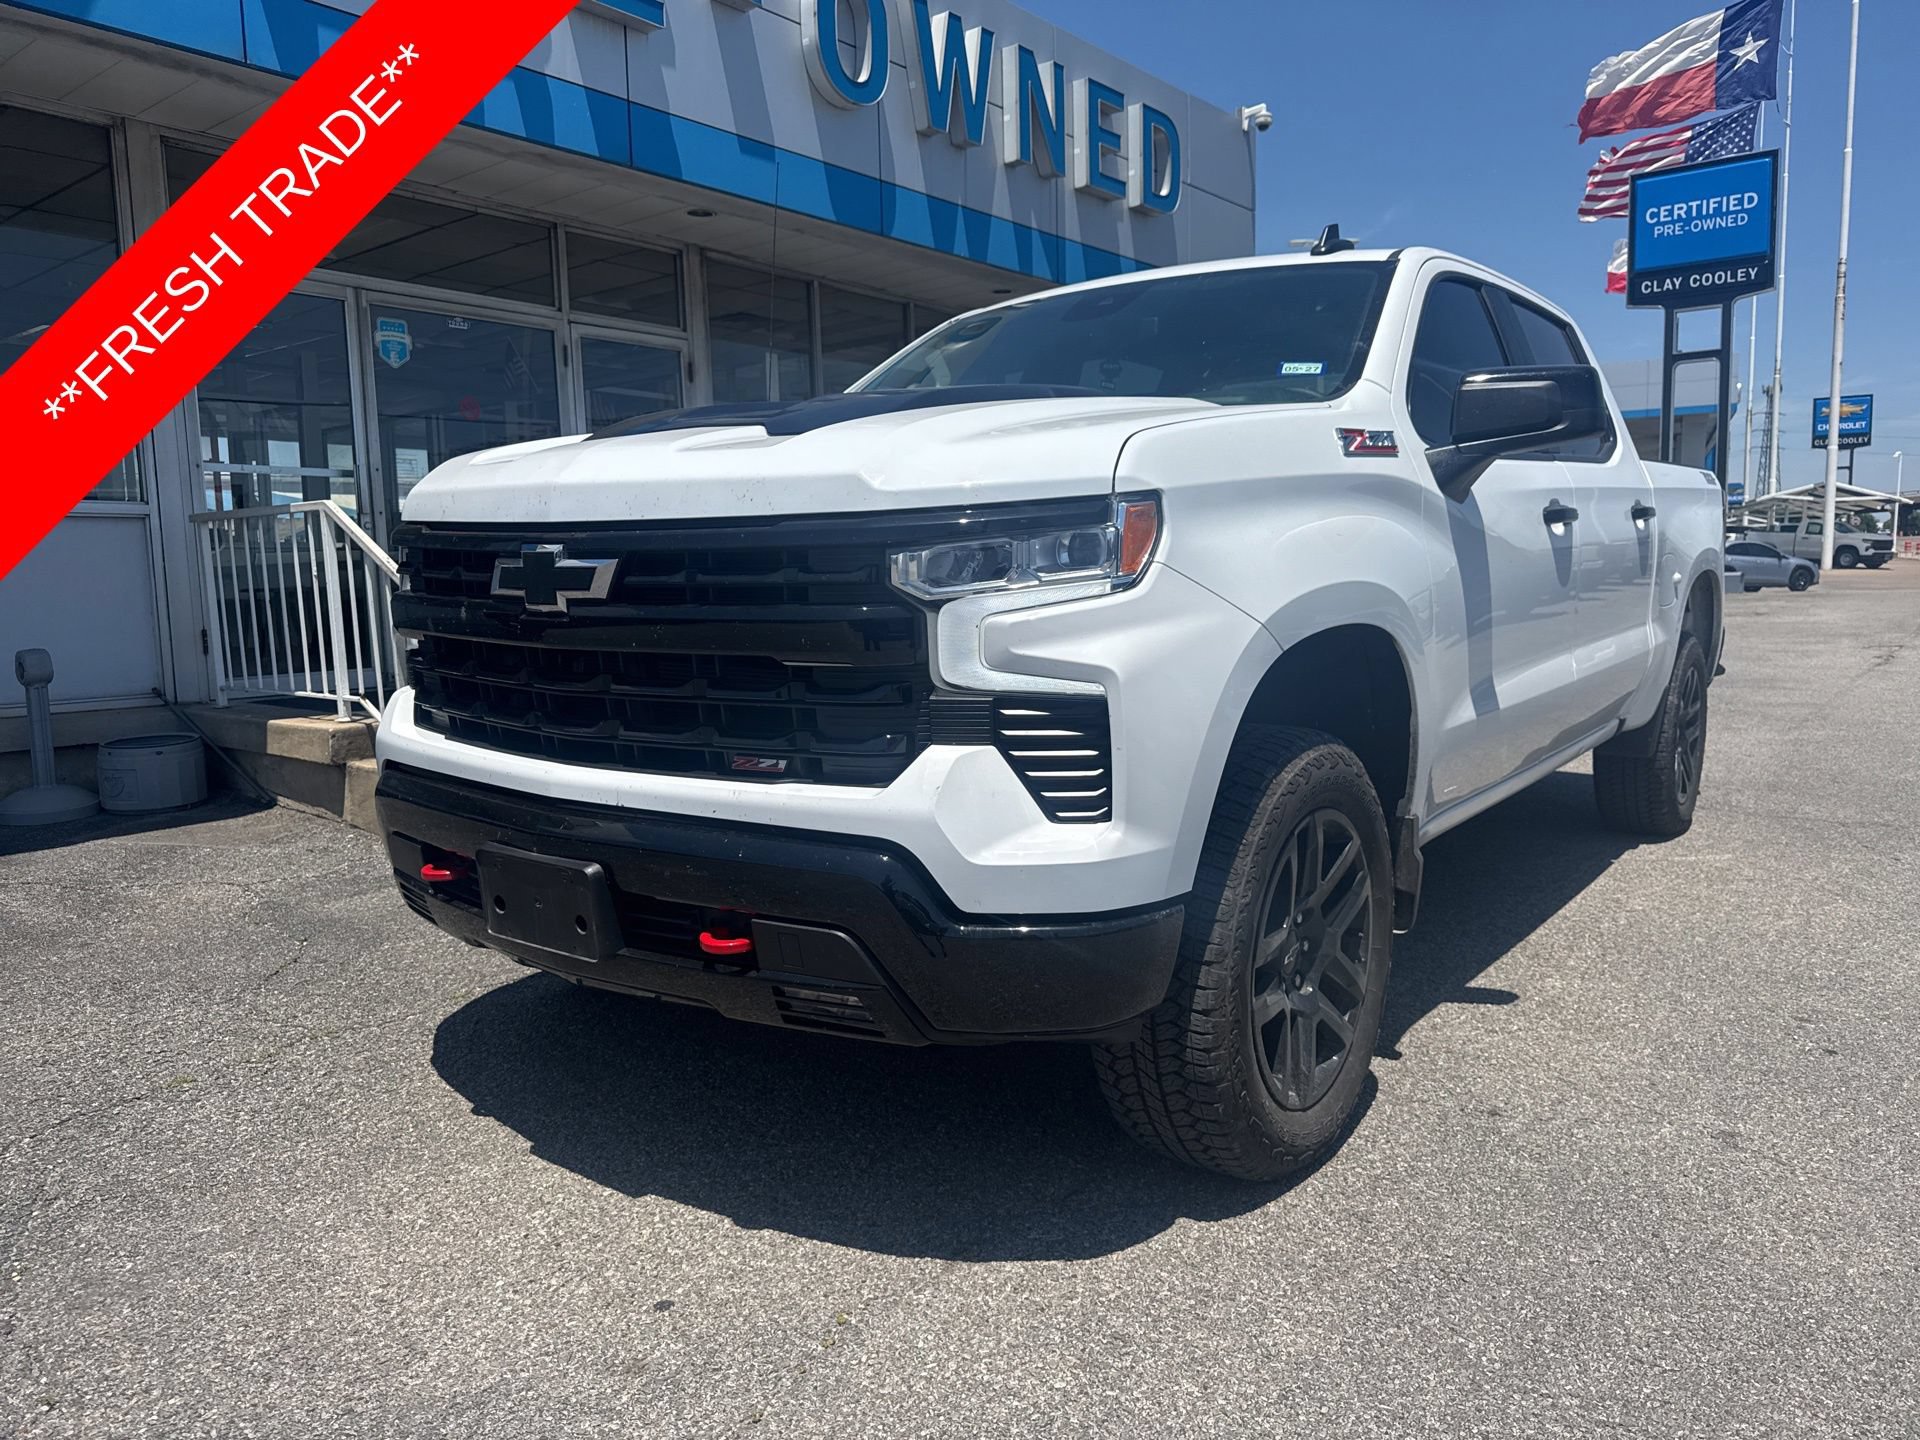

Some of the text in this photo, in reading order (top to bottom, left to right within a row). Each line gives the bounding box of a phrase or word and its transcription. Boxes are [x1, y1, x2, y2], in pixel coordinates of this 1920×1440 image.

[1645, 191, 1759, 224] CERTIFIED
[1654, 212, 1749, 238] PRE-OWNED
[1641, 266, 1759, 295] CLAY COOLEY
[1817, 421, 1867, 431] CHROLET
[731, 756, 788, 772] Z71
